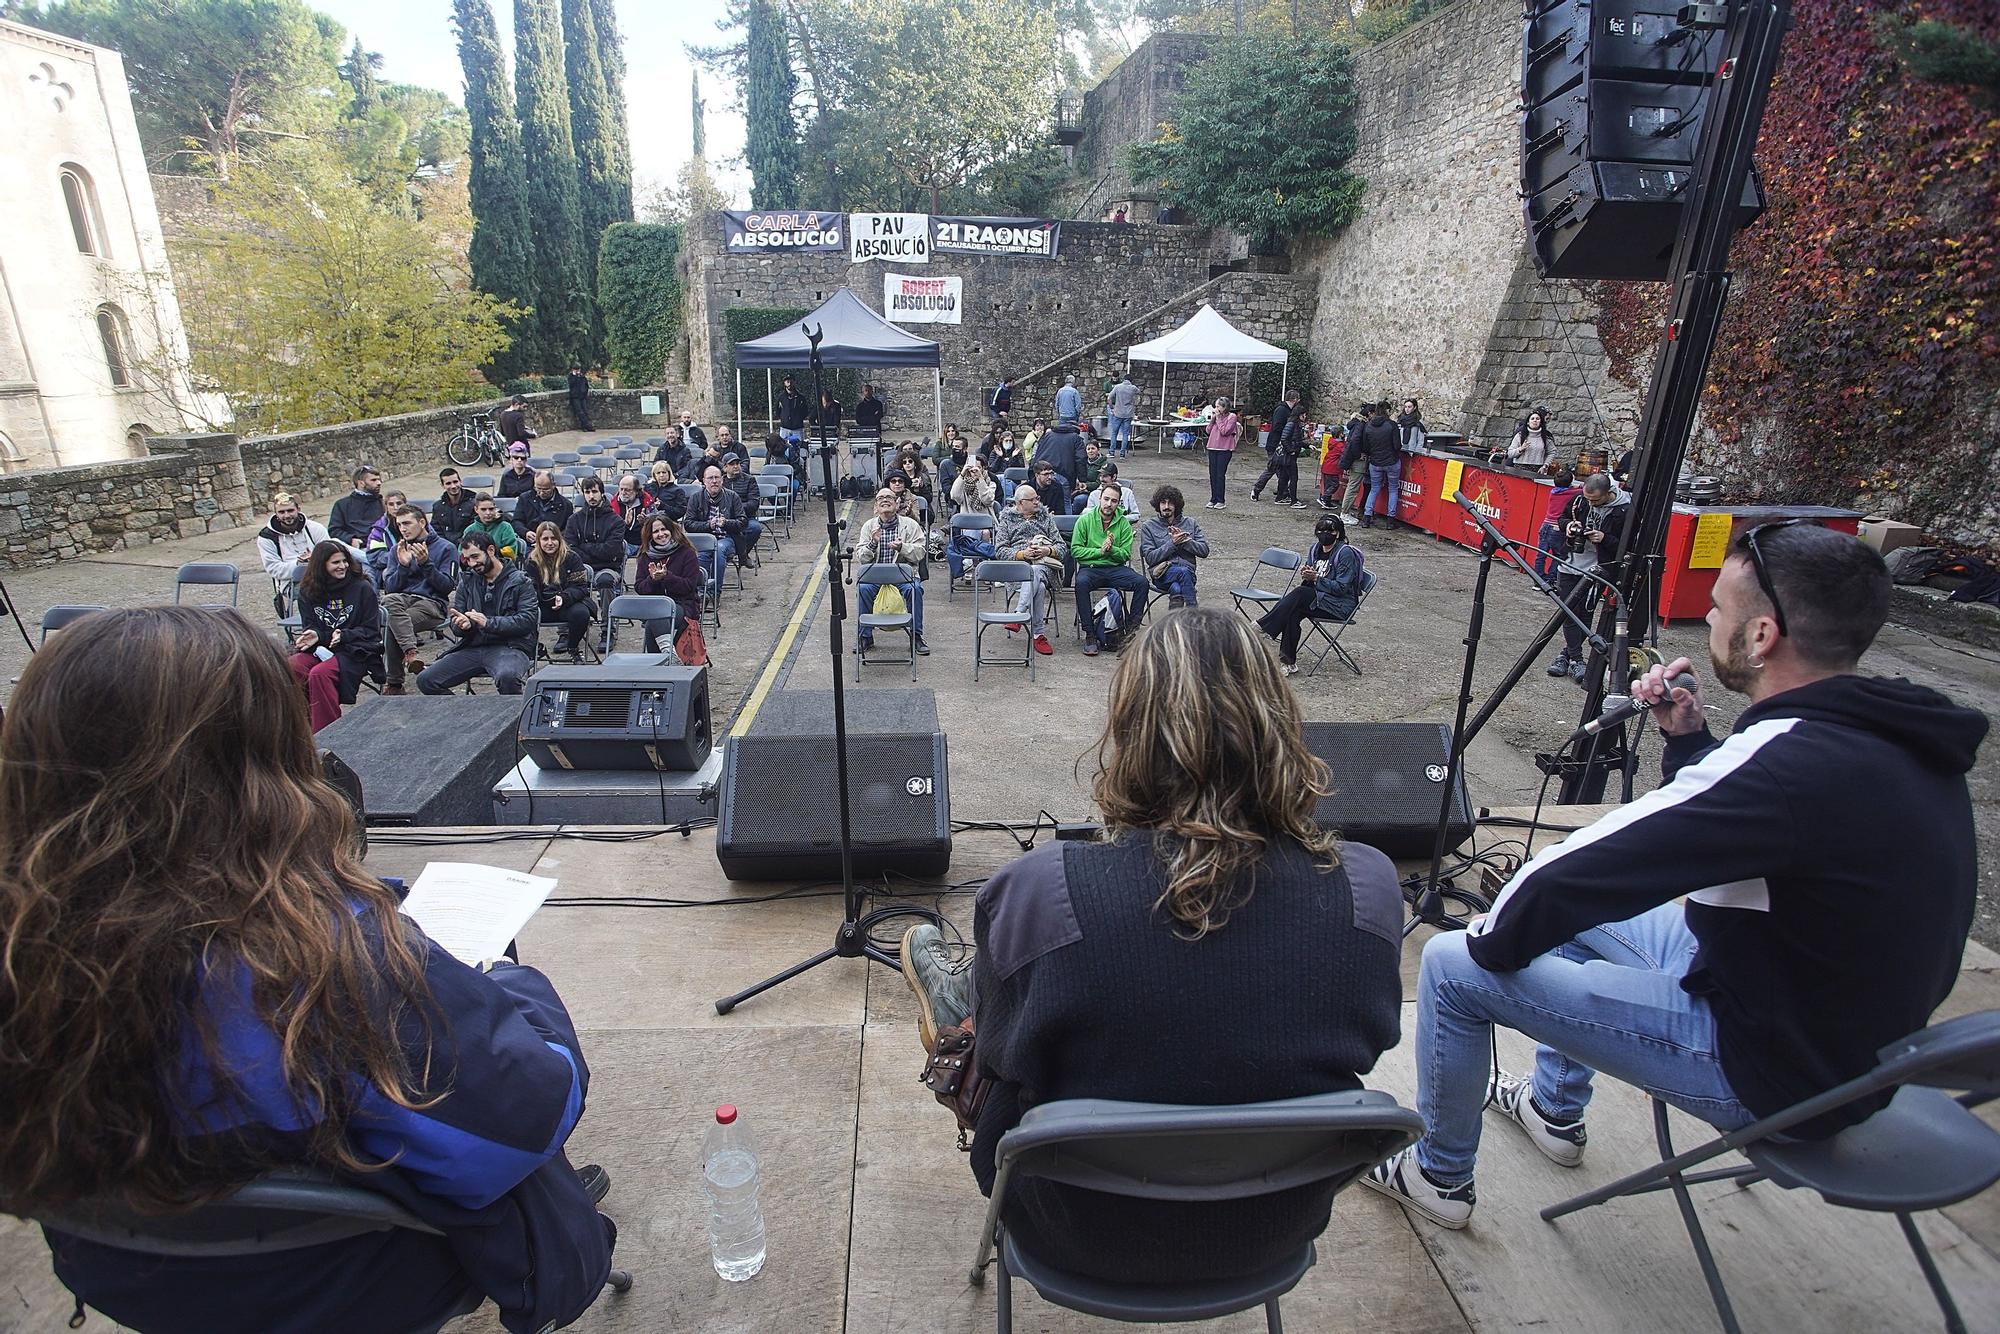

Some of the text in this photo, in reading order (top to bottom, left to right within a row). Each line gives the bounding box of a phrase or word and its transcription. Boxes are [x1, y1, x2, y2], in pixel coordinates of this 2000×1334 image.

[745, 213, 820, 231] CARLA
[872, 217, 904, 235] PAU
[729, 226, 840, 247] ABSOLUCIÓ
[936, 222, 959, 241] 21
[936, 241, 986, 251] ENCAUSADES
[986, 243, 991, 251] 1
[991, 245, 1026, 253] OCTUBRE
[901, 280, 946, 295] ROBERT
[893, 293, 955, 311] ABSOLUCIÓ
